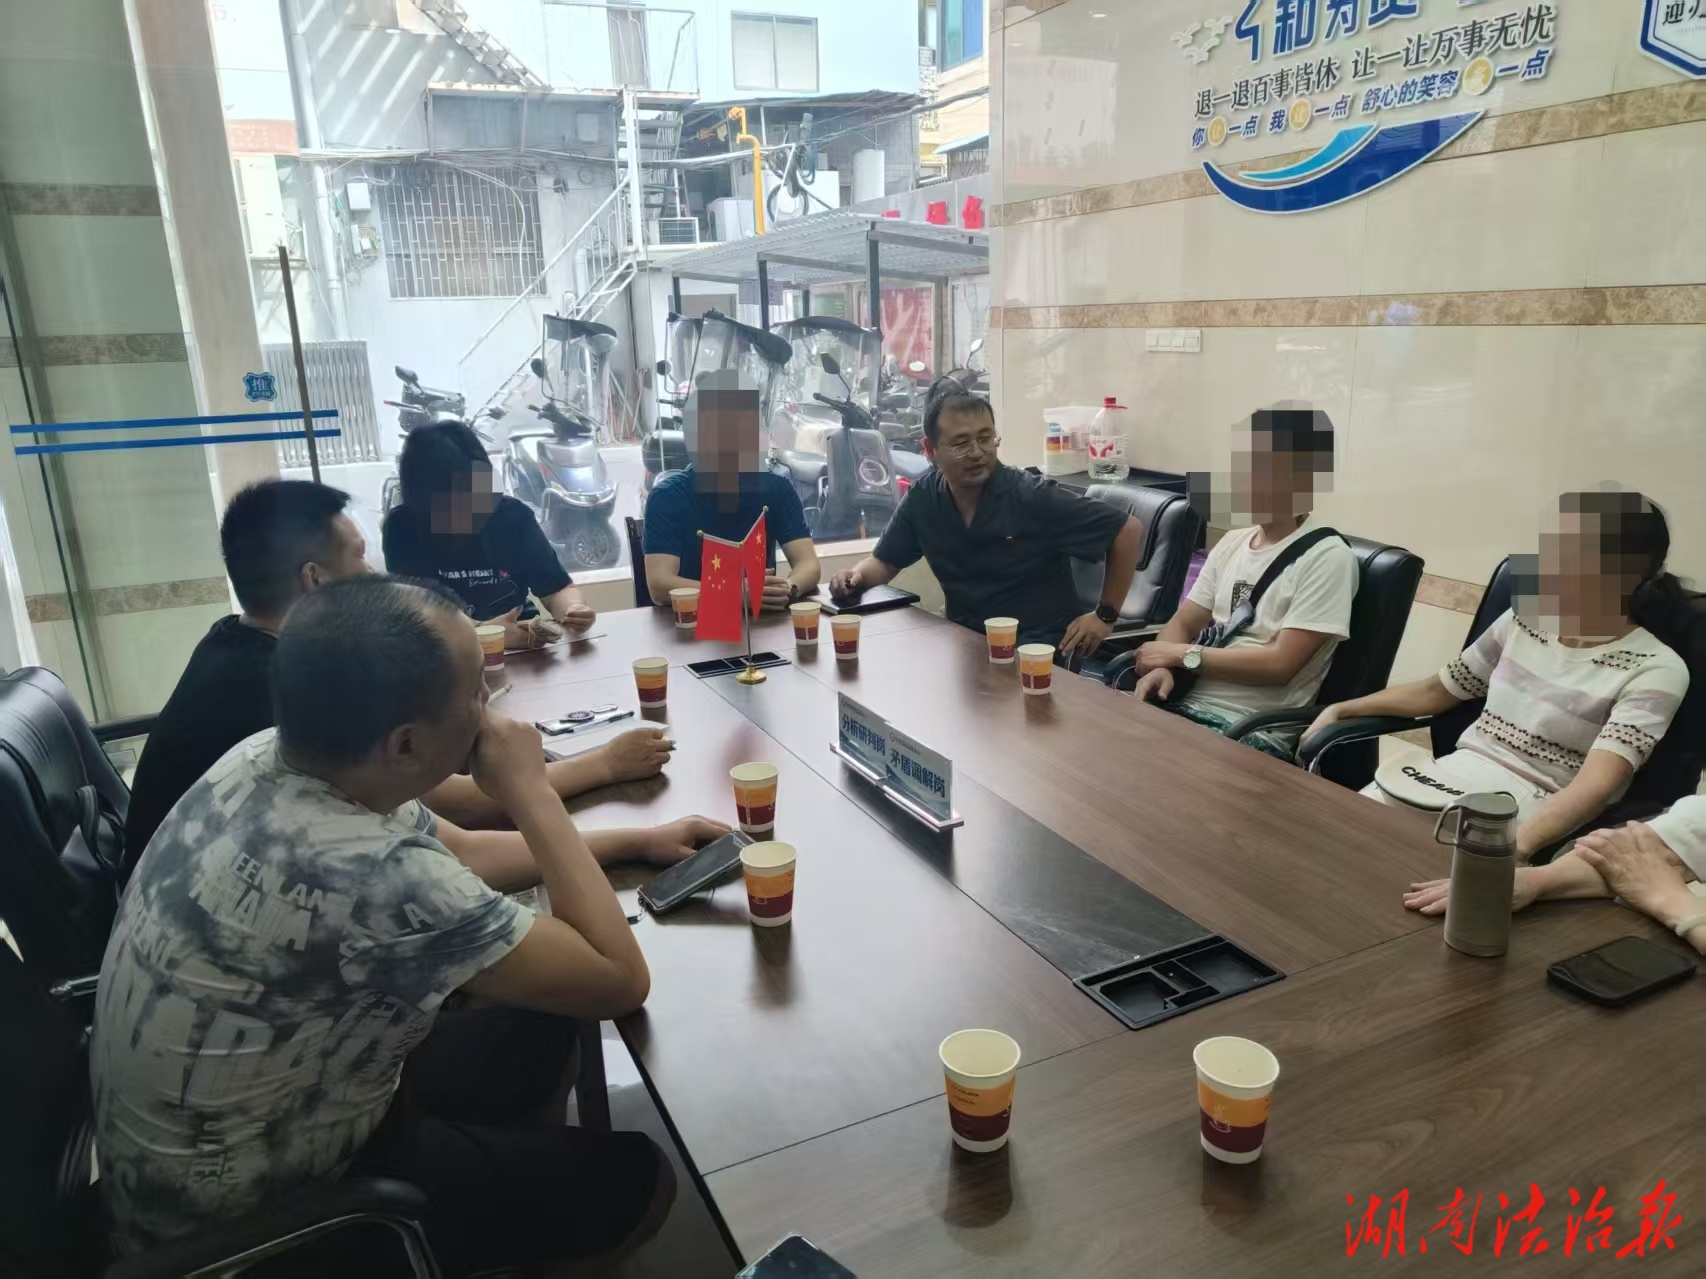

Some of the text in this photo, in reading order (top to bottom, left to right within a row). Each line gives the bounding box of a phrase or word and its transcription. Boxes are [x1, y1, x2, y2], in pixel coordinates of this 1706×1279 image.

[1194, 4, 1553, 118] 退一退百事皆休 让一让万事无忧
[841, 713, 886, 757] 分析研判岗
[890, 748, 946, 799] 矛盾调解岗
